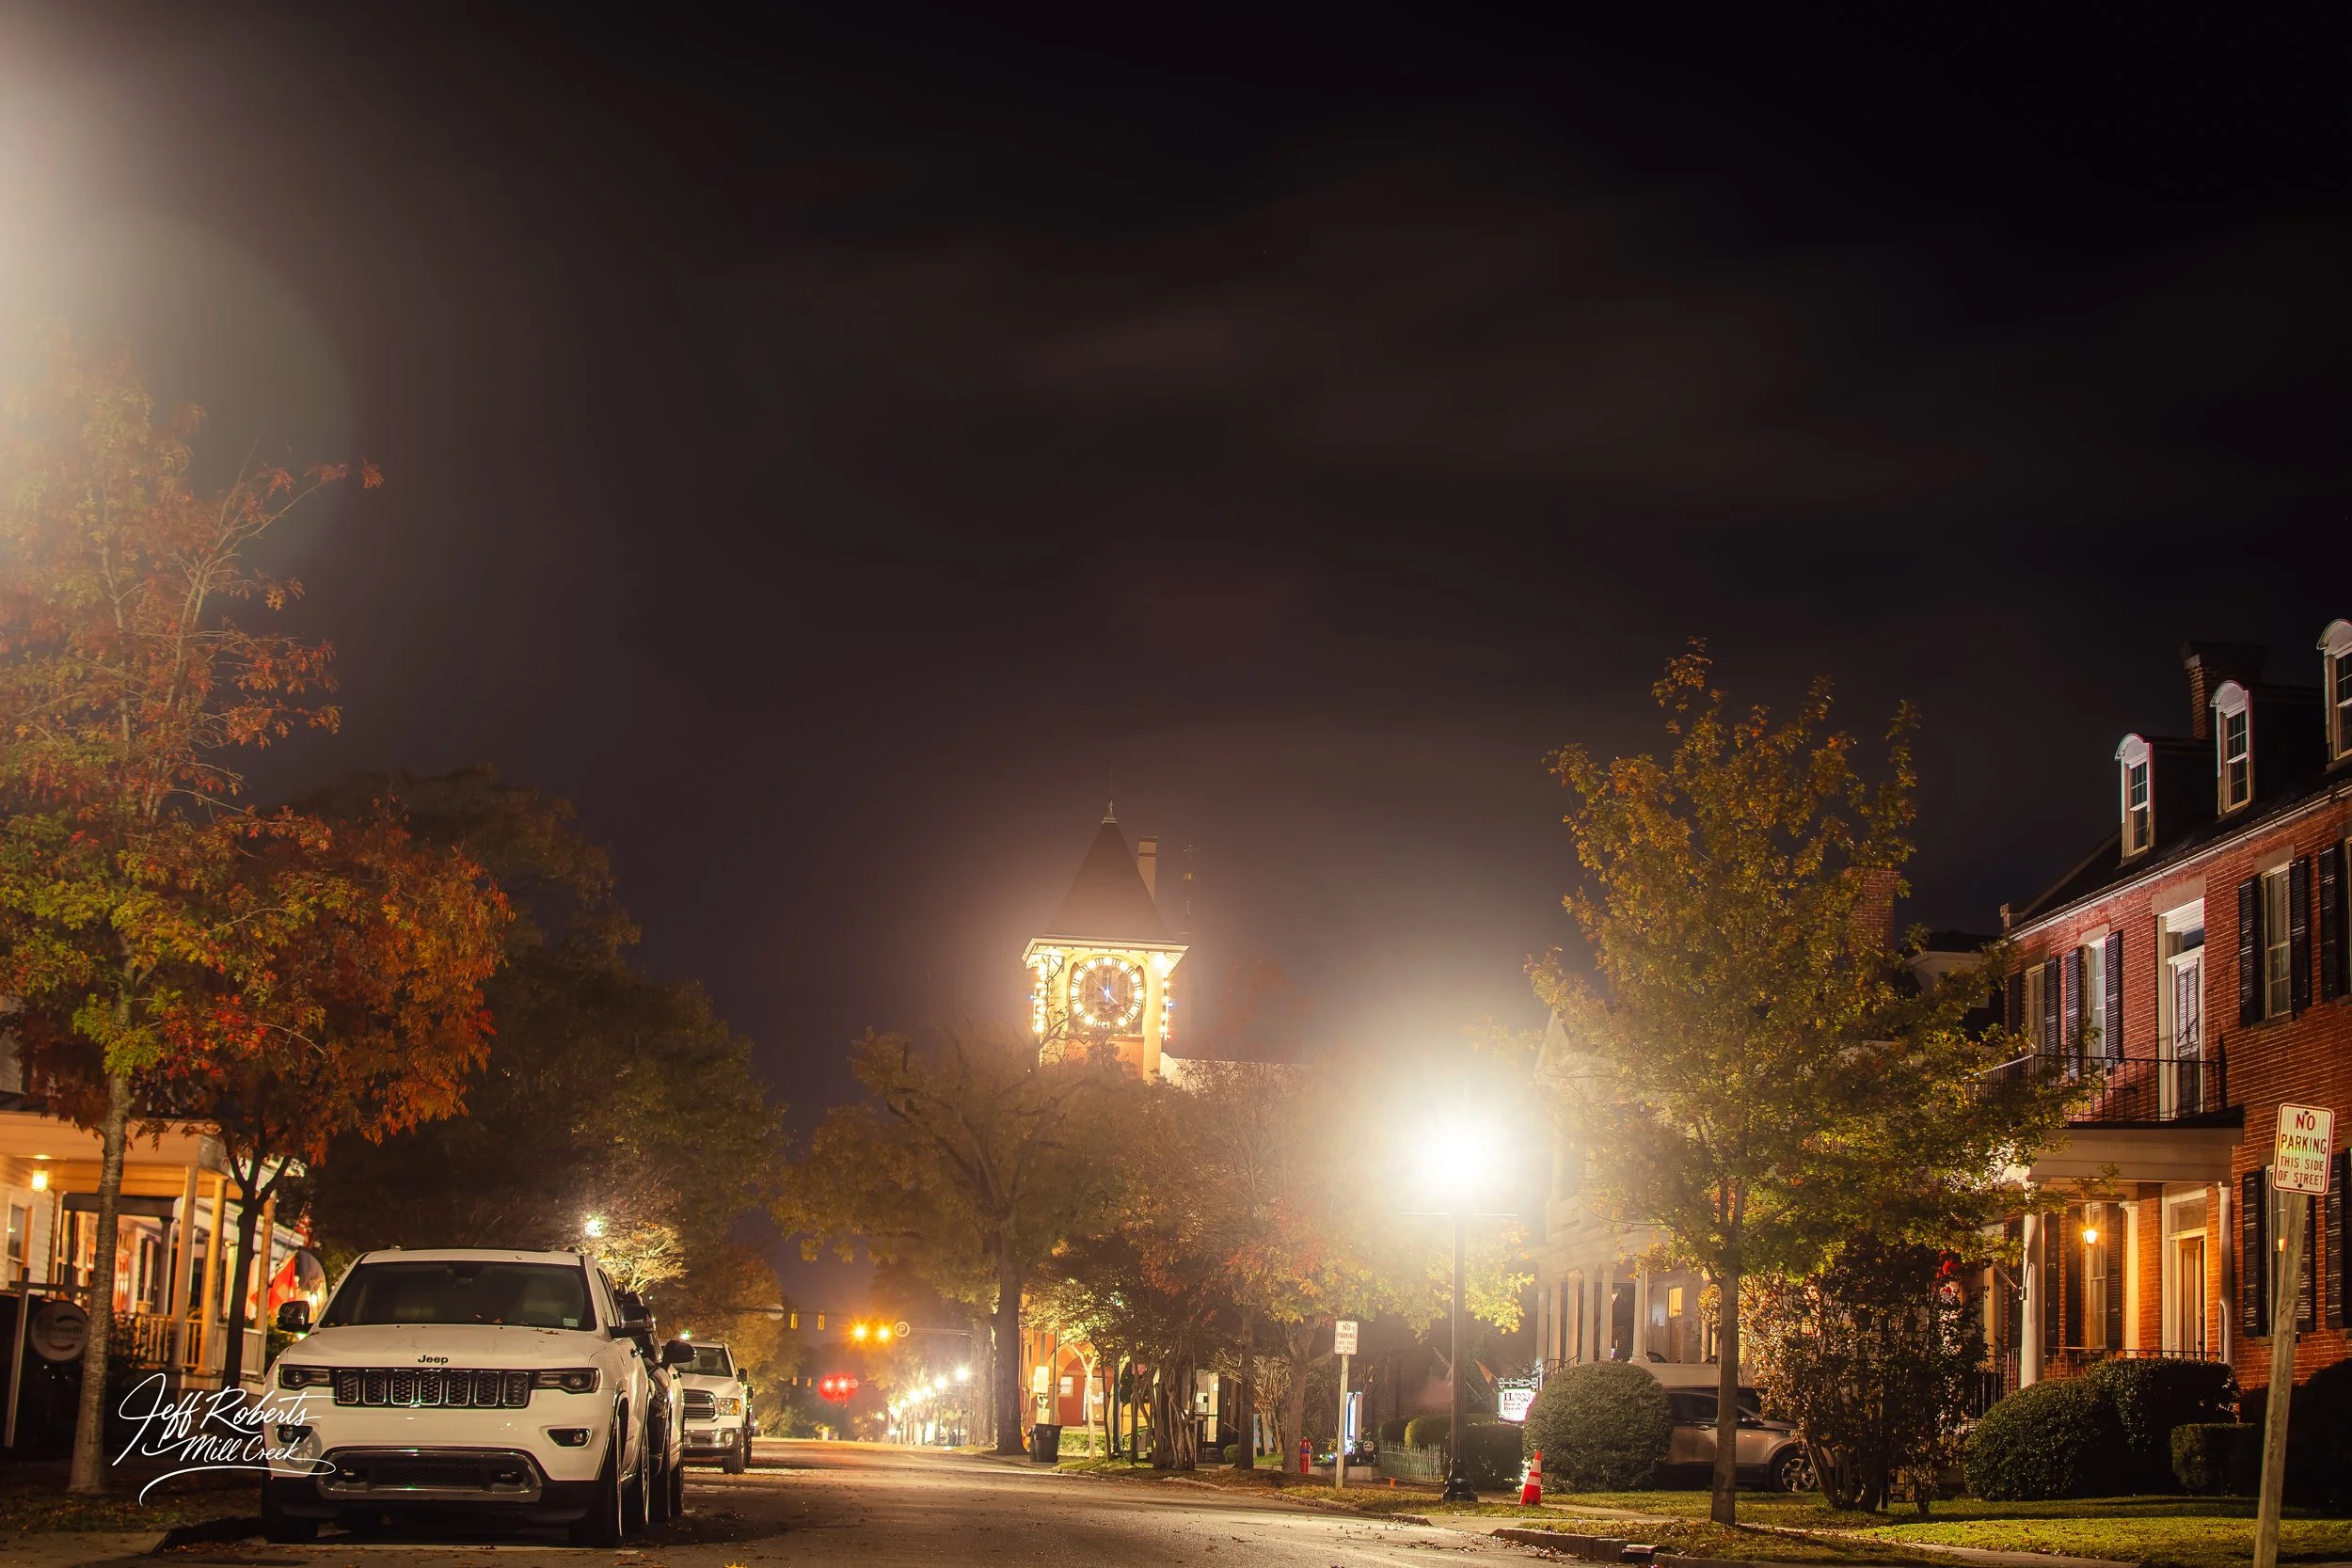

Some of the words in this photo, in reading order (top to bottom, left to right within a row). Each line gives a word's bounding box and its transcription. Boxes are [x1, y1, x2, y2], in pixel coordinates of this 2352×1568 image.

[2296, 1114, 2315, 1131] NO
[2280, 1134, 2327, 1154] PARKING
[2280, 1156, 2299, 1168] THIS
[2304, 1159, 2324, 1171] SIDE
[2278, 1170, 2288, 1181] OF
[2294, 1172, 2324, 1186] STREET
[418, 1354, 449, 1365] Jeep
